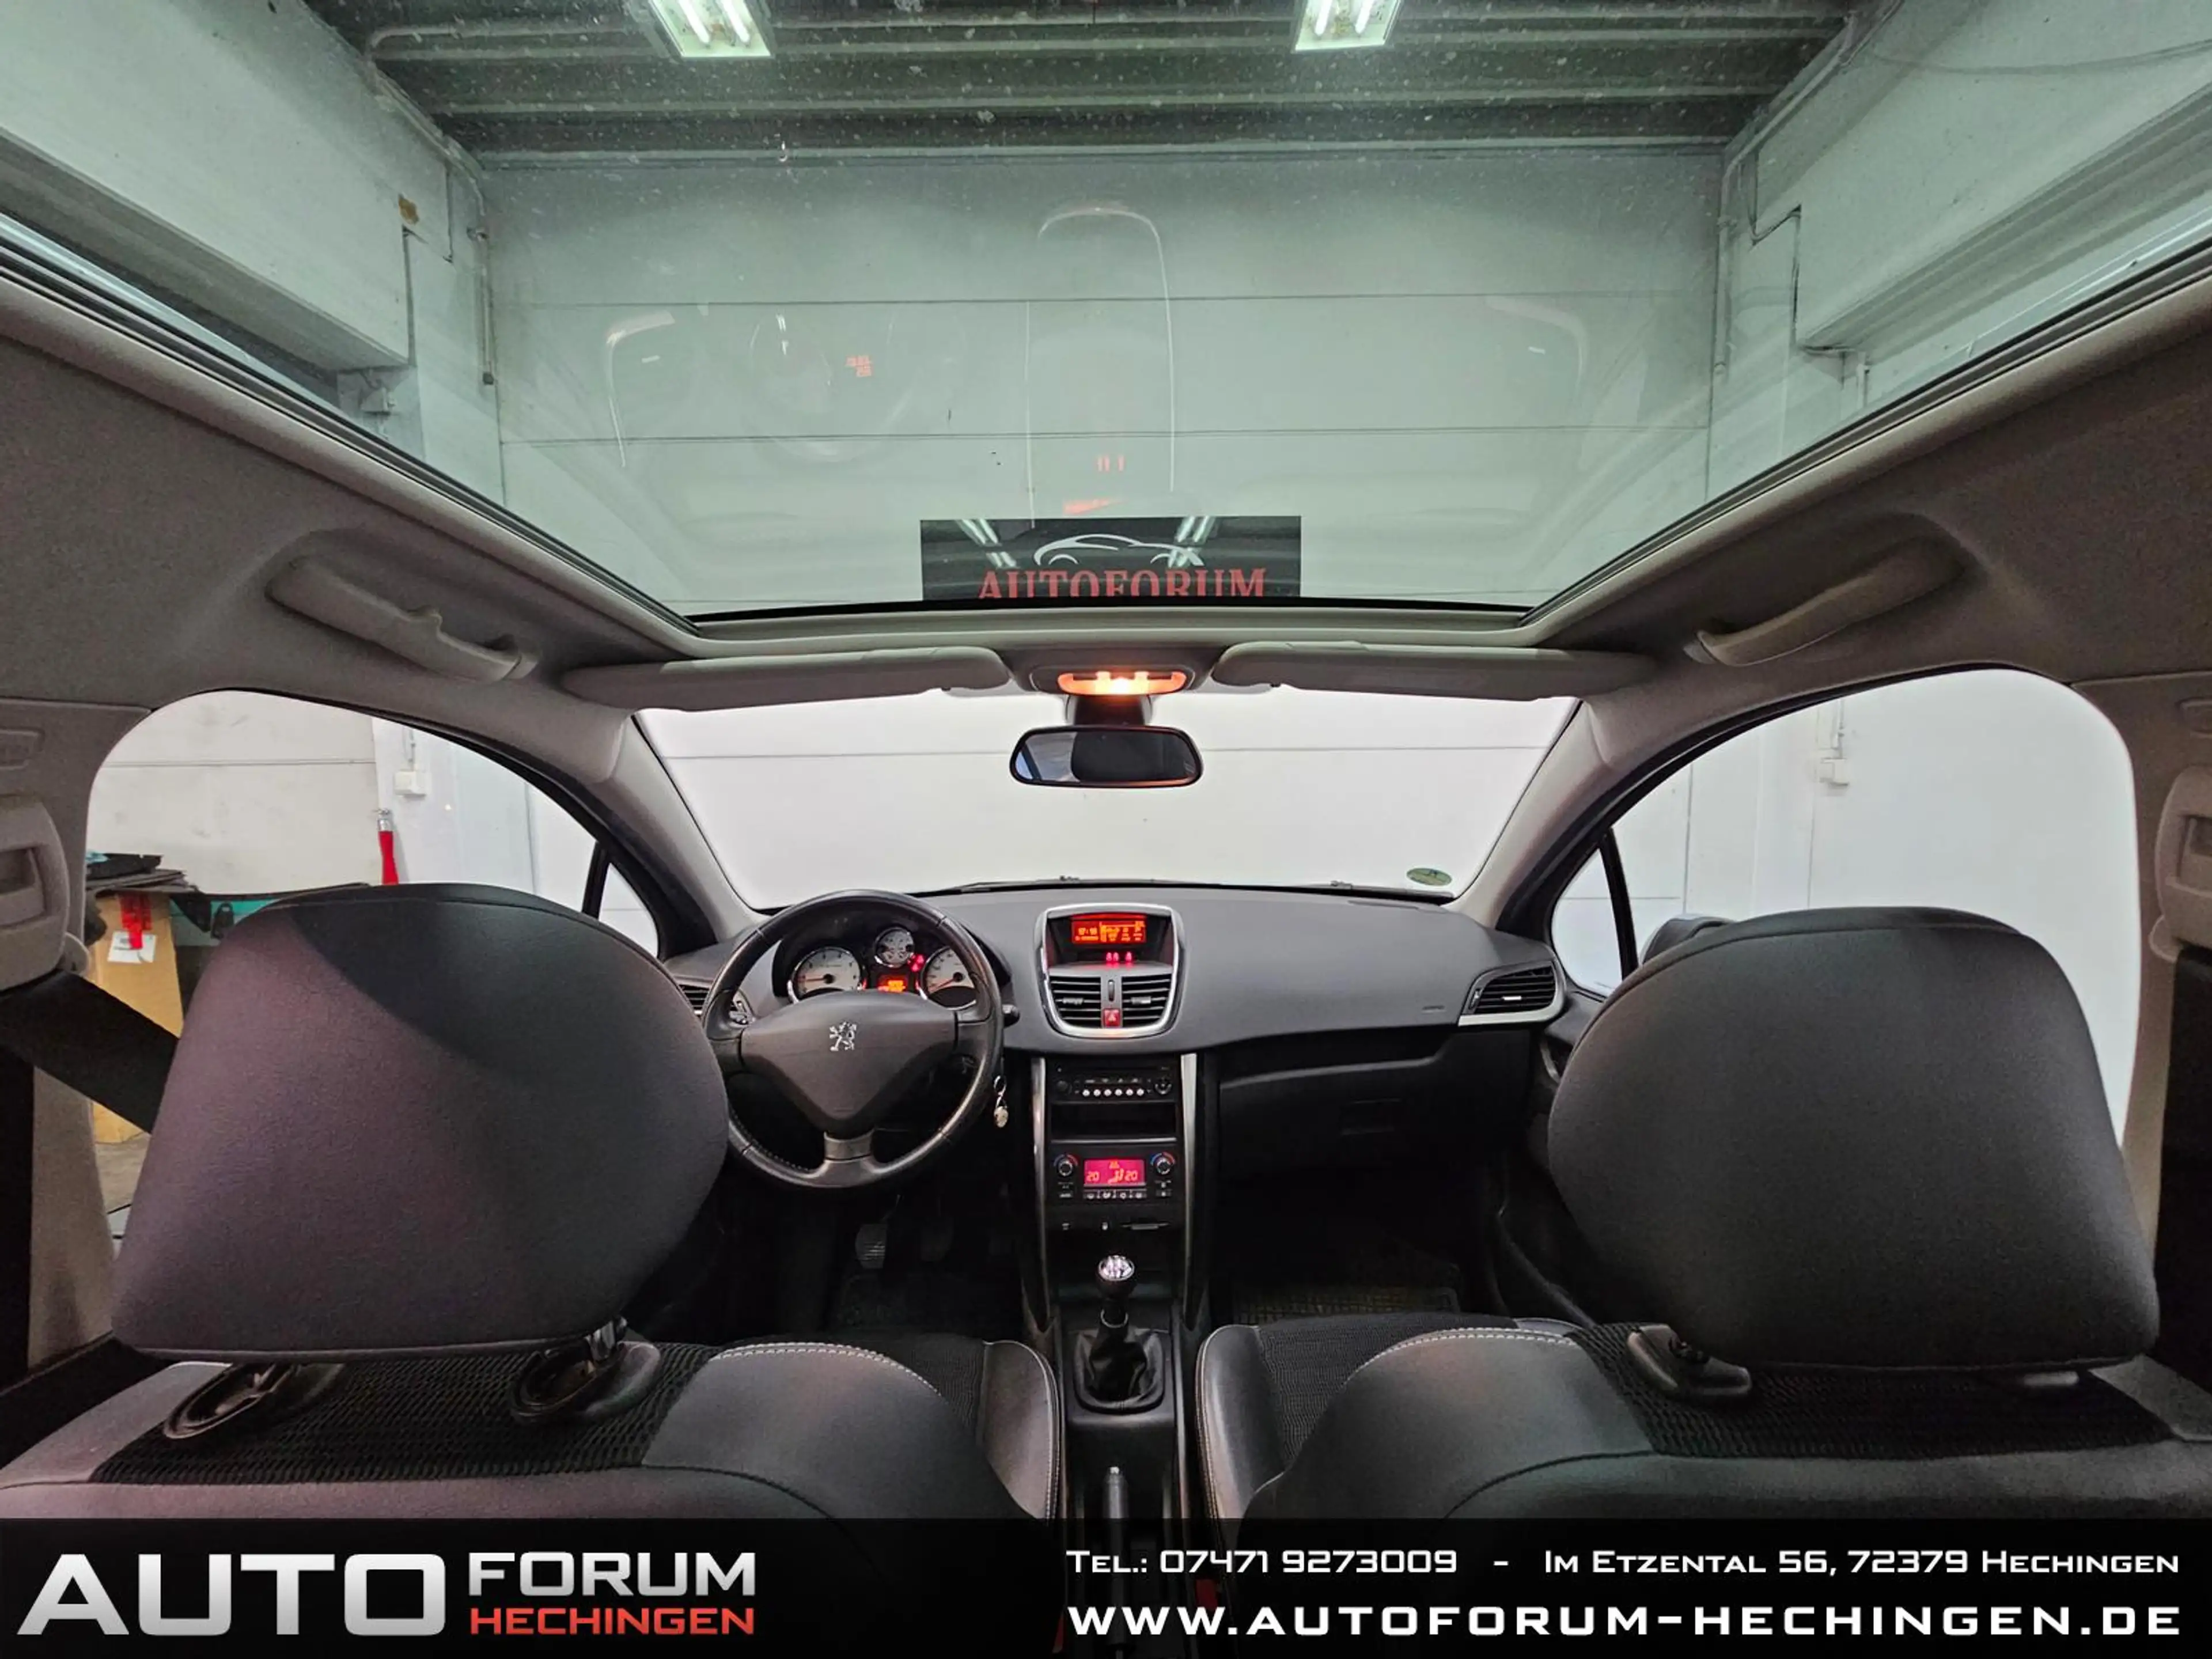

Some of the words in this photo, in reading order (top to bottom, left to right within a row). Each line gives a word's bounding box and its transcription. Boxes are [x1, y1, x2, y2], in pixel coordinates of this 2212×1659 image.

[979, 567, 1266, 599] AUTOFORUM
[1086, 1170, 1100, 1183] 20
[1124, 1169, 1138, 1182] 20
